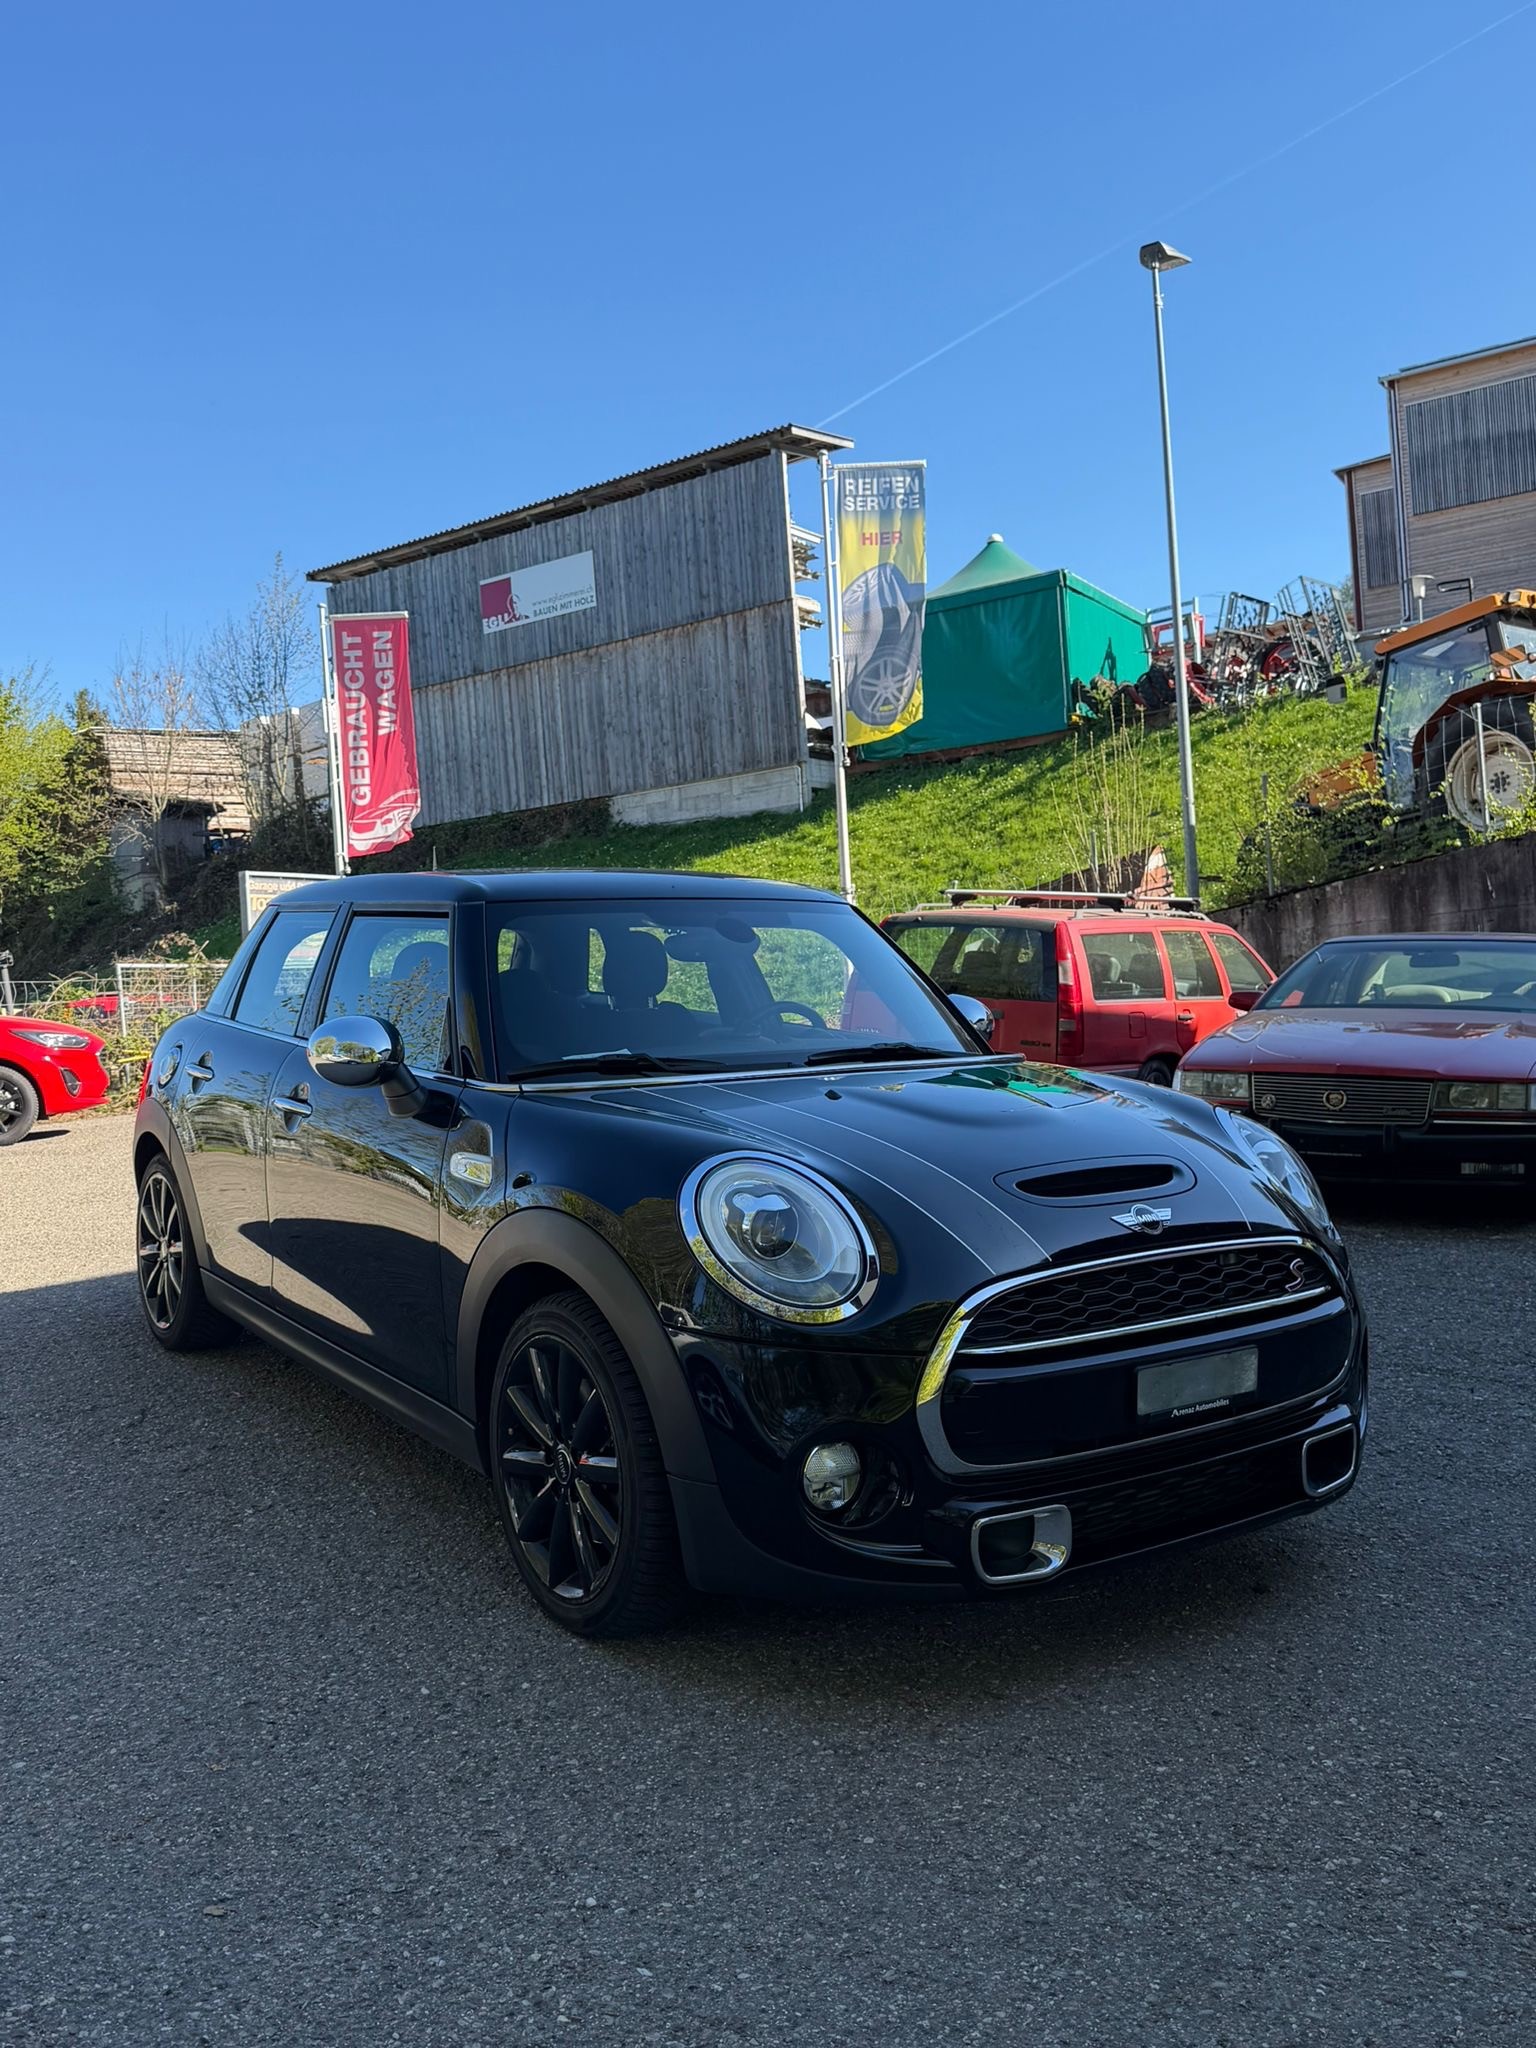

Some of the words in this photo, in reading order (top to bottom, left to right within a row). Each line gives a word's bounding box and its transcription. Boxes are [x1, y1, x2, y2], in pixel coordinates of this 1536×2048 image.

[845, 476, 919, 495] REIFEN
[844, 494, 920, 511] SERVICE
[861, 531, 903, 546] HIER
[533, 604, 558, 617] BAUEN
[560, 600, 573, 611] MIT
[574, 595, 595, 607] HOLZ
[373, 631, 397, 736] WAGEN
[342, 632, 371, 806] GEBRAUCHT
[249, 880, 278, 893] Garage
[1137, 1213, 1159, 1223] MINI
[1285, 1258, 1304, 1292] S
[1195, 1399, 1230, 1412] Automobiles
